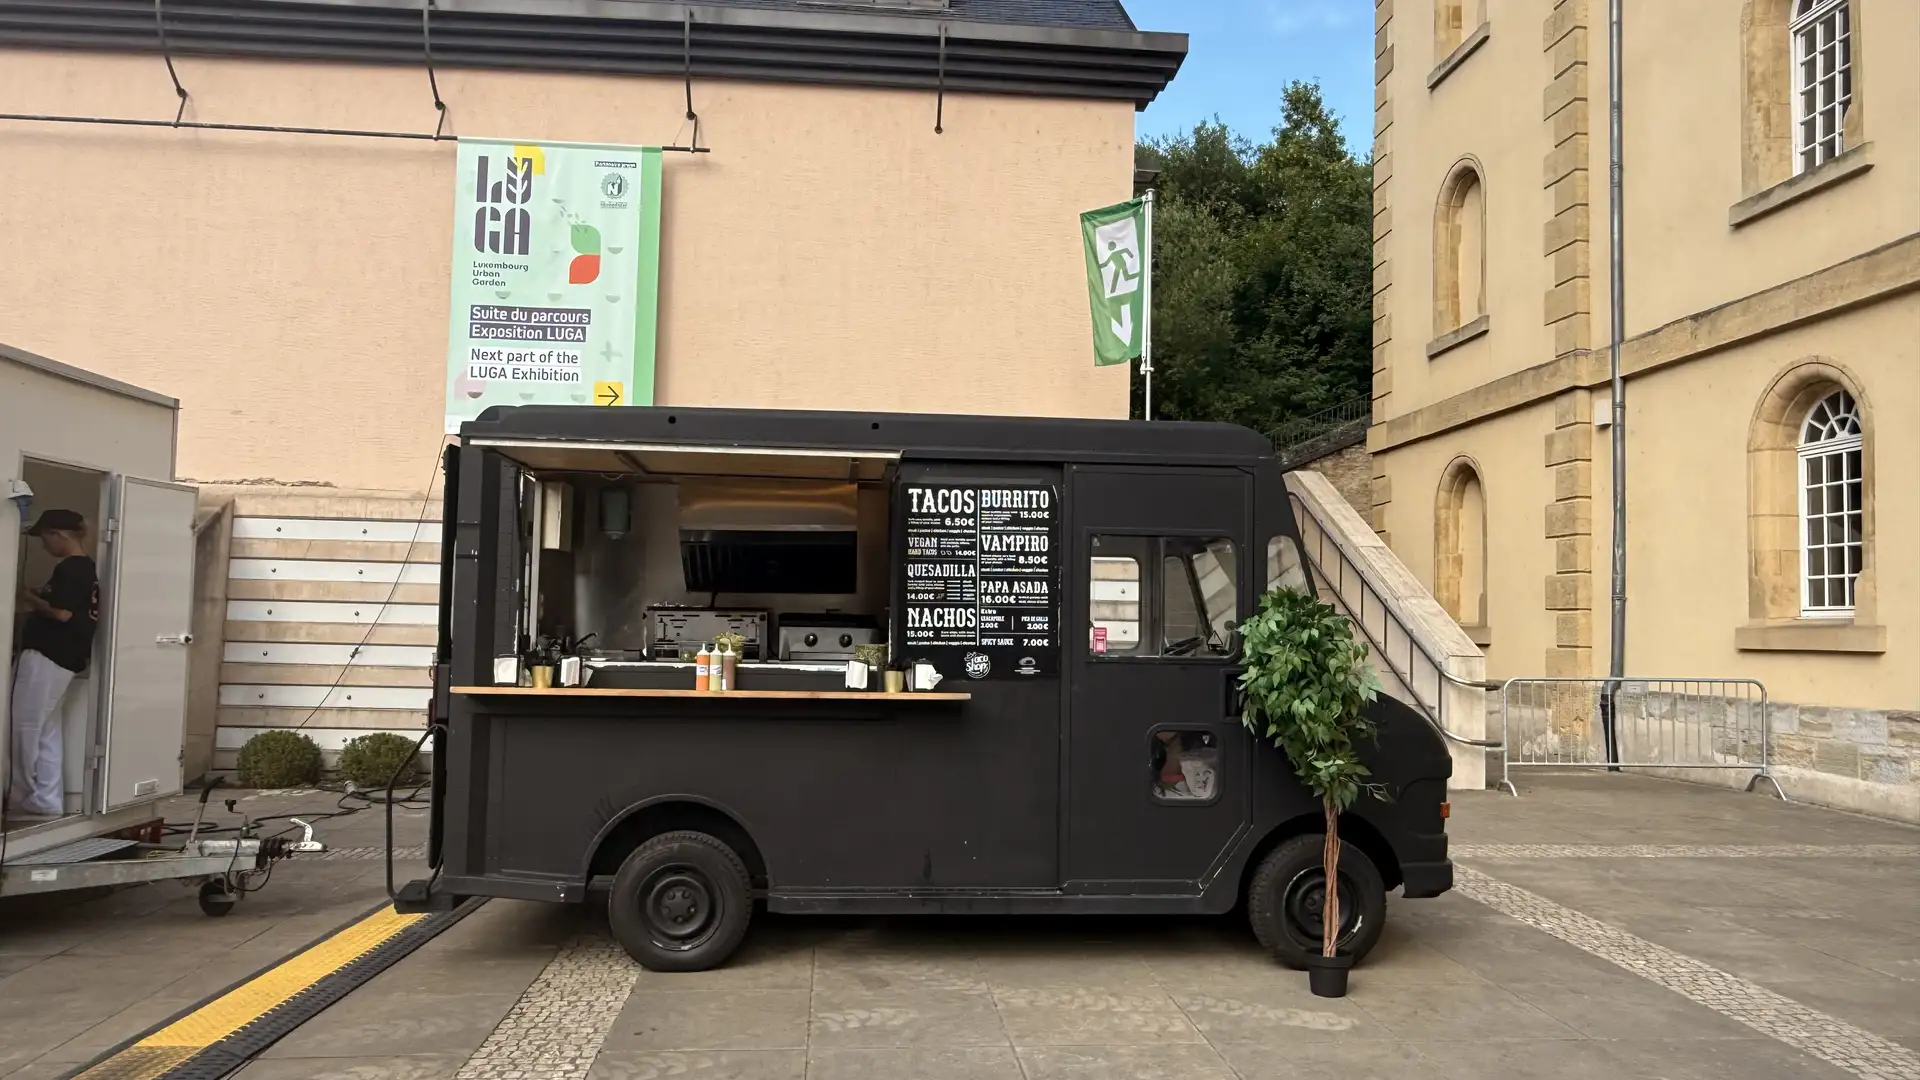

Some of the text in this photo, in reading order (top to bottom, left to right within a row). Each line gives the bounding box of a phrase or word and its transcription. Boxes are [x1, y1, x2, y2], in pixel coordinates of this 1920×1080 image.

[472, 278, 506, 286] Garden
[471, 307, 588, 324] Suite du parcours
[471, 324, 585, 340] Exposition LUGA
[472, 349, 578, 364] Next part of the
[471, 366, 578, 381] LUGA Exhibition
[908, 489, 974, 513] TACOS
[982, 490, 1049, 508] BURRITO
[945, 518, 974, 526] 6.50€
[908, 537, 937, 547] VEGAN
[981, 535, 1048, 551] VAMPIRO
[908, 564, 976, 577] QUESADILLA
[981, 581, 1009, 593] PAPA
[1013, 581, 1048, 593] ASADA
[981, 595, 1016, 603] 16.00€
[908, 608, 975, 627] NACHOS
[982, 638, 997, 646] SPICY
[998, 638, 1014, 646] SAUCE
